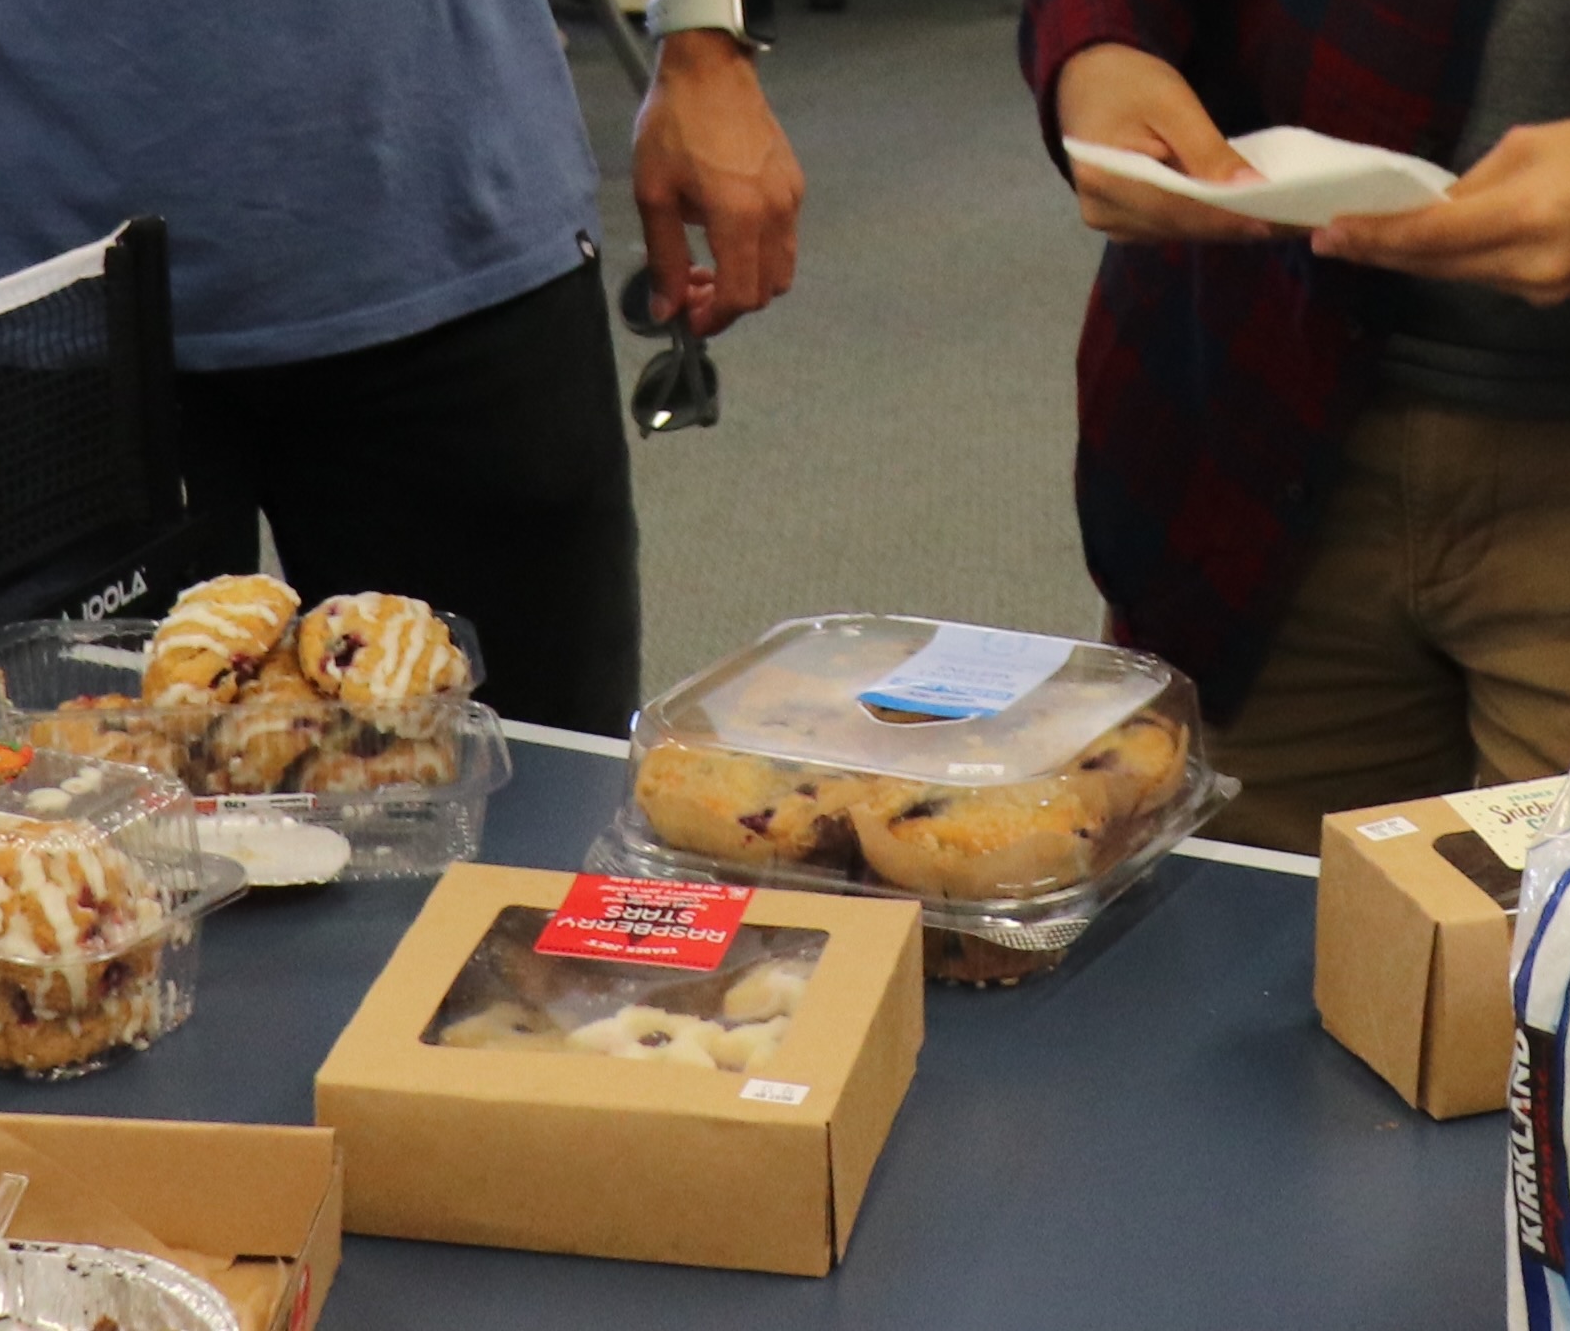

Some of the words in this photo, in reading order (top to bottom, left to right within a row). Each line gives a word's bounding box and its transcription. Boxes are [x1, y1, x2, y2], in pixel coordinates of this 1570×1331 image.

[604, 904, 697, 925] STARS
[556, 917, 728, 944] RASPBERRY
[625, 944, 678, 955] TRADER
[1510, 1028, 1546, 1255] KIRKLAND
